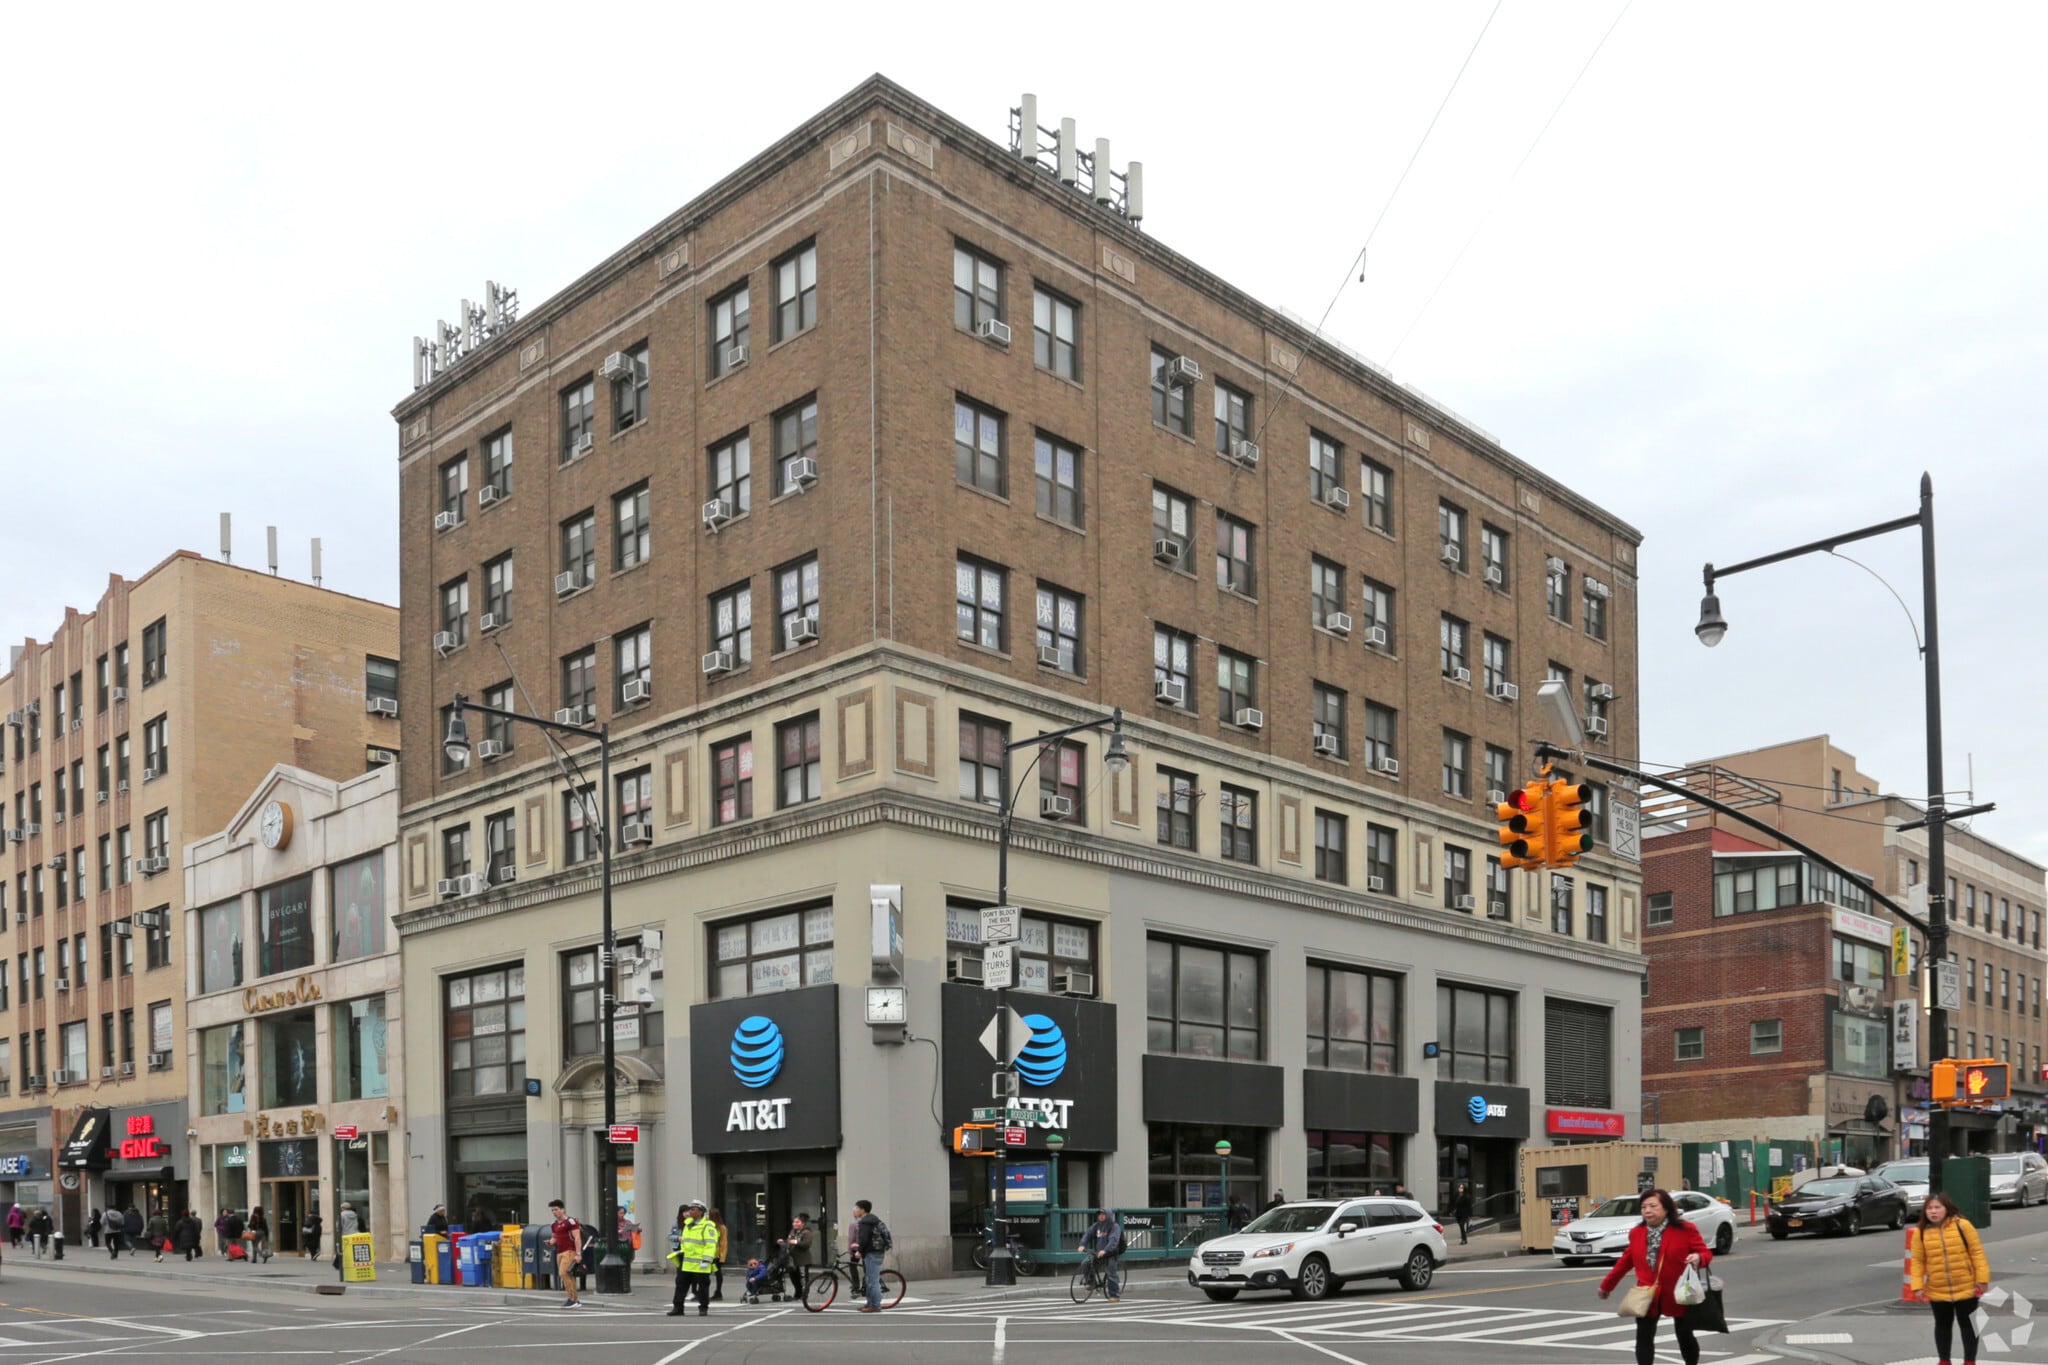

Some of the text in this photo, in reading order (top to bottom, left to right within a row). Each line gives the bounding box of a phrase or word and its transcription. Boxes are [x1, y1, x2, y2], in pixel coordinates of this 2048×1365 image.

[1000, 908, 1016, 916] BLOCK
[992, 950, 1004, 958] NO
[986, 961, 1010, 970] TURNS
[726, 1098, 792, 1132] AT&T
[973, 1109, 985, 1120] MAIN
[1005, 1097, 1074, 1129] AT&T
[1011, 1110, 1039, 1121] ROOSEVELT
[1487, 1104, 1508, 1117] AT&T
[1559, 1116, 1575, 1128] Bank
[1583, 1117, 1605, 1130] America
[121, 1137, 161, 1159] GNC
[1123, 1215, 1152, 1226] Subway
